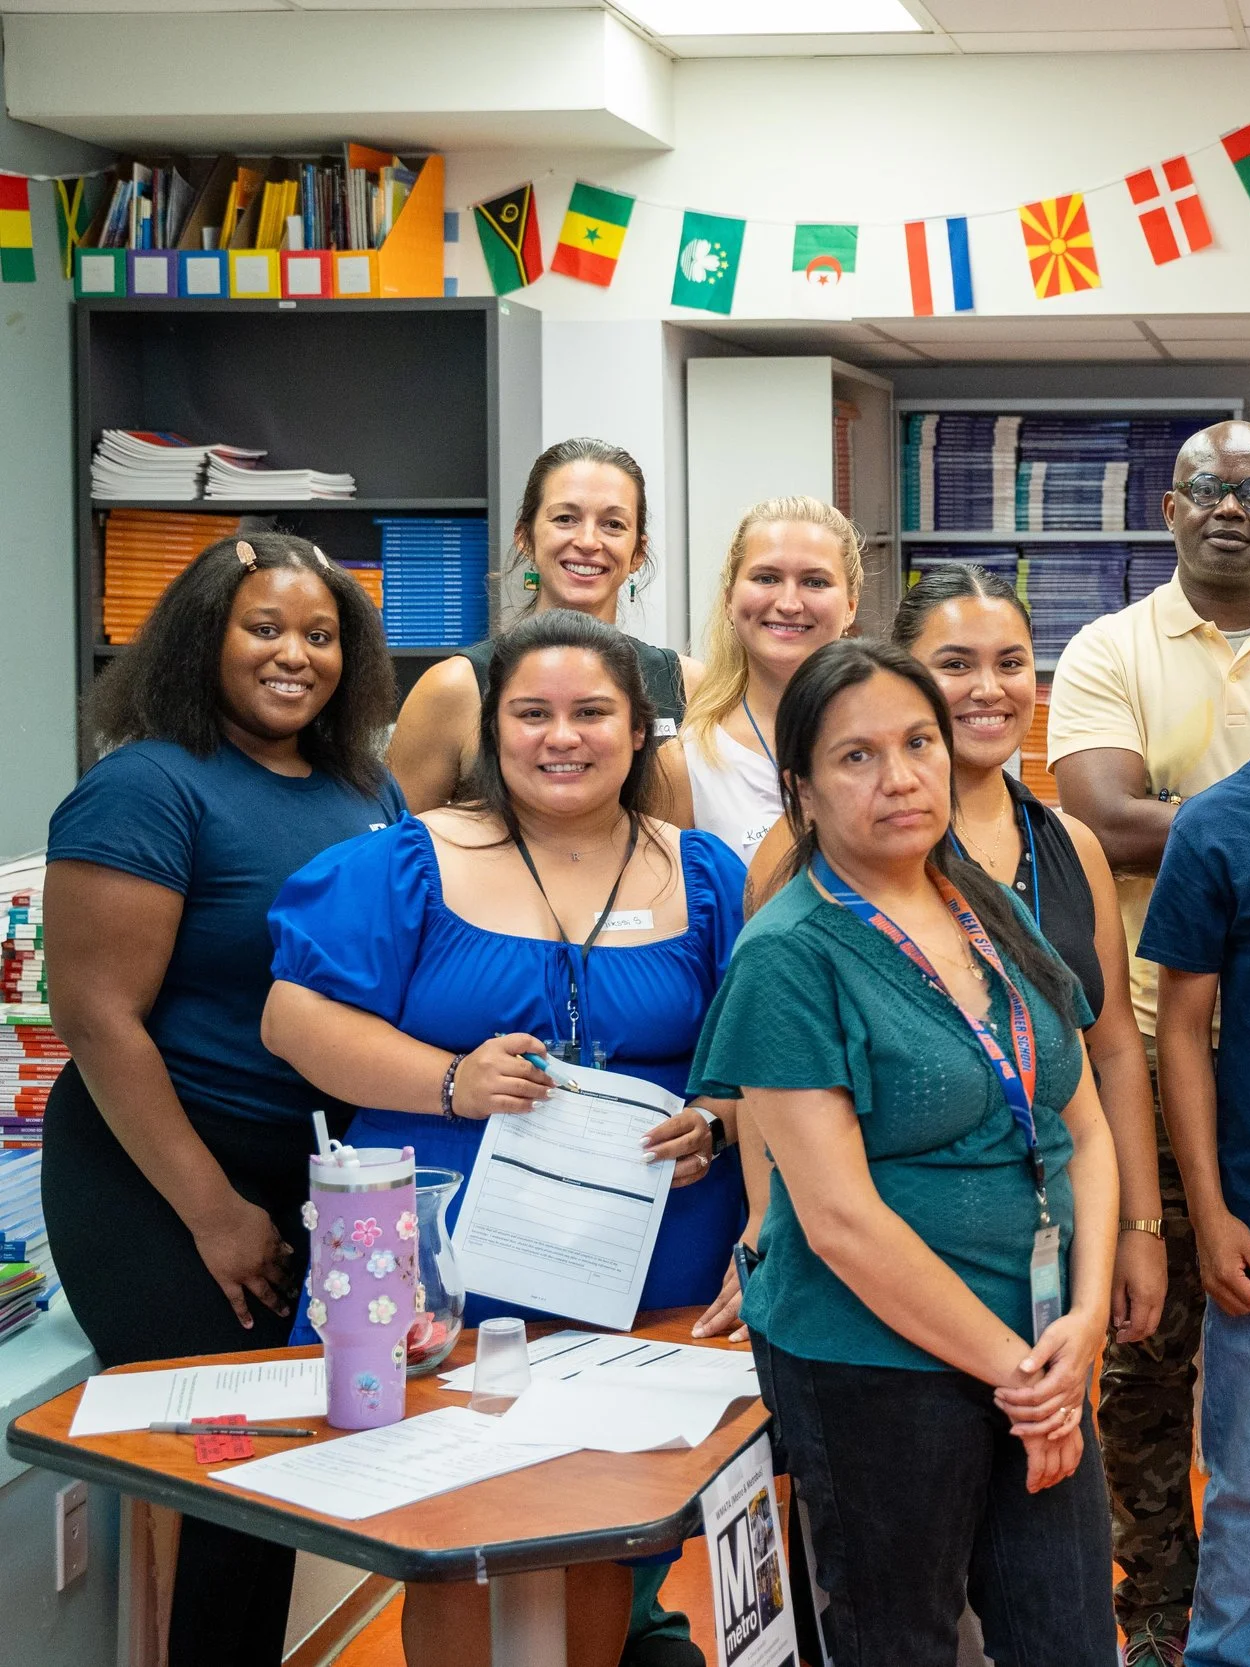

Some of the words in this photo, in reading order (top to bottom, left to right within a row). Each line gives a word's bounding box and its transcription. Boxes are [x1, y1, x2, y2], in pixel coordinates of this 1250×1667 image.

[957, 912, 983, 936] NEXT
[1016, 1035, 1032, 1071] SCHOOL
[719, 1515, 756, 1630] M
[726, 1609, 758, 1657] metro
